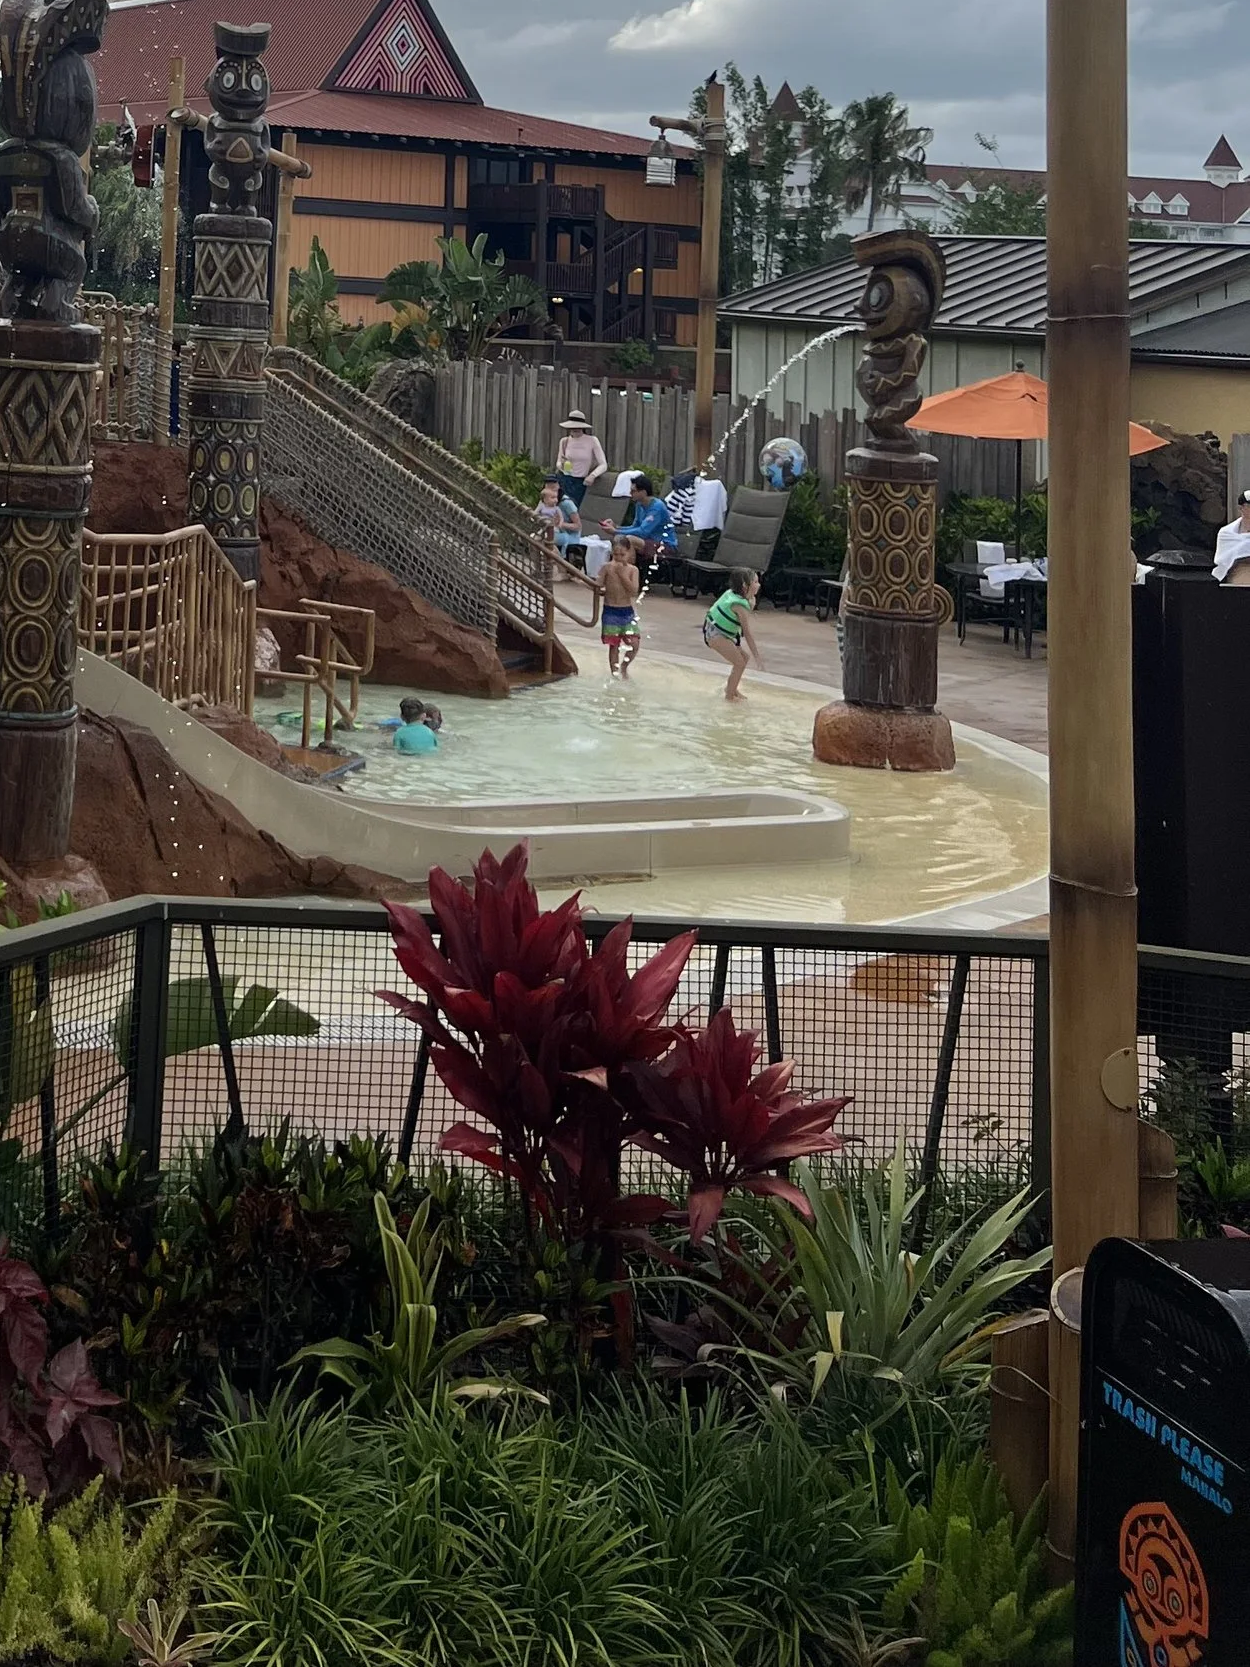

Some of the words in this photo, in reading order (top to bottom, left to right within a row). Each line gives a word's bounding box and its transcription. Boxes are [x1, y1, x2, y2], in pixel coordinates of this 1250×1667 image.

[1103, 1381, 1157, 1438] TRASH
[1161, 1424, 1225, 1487] PLEASE
[1181, 1466, 1233, 1514] MAHALO
